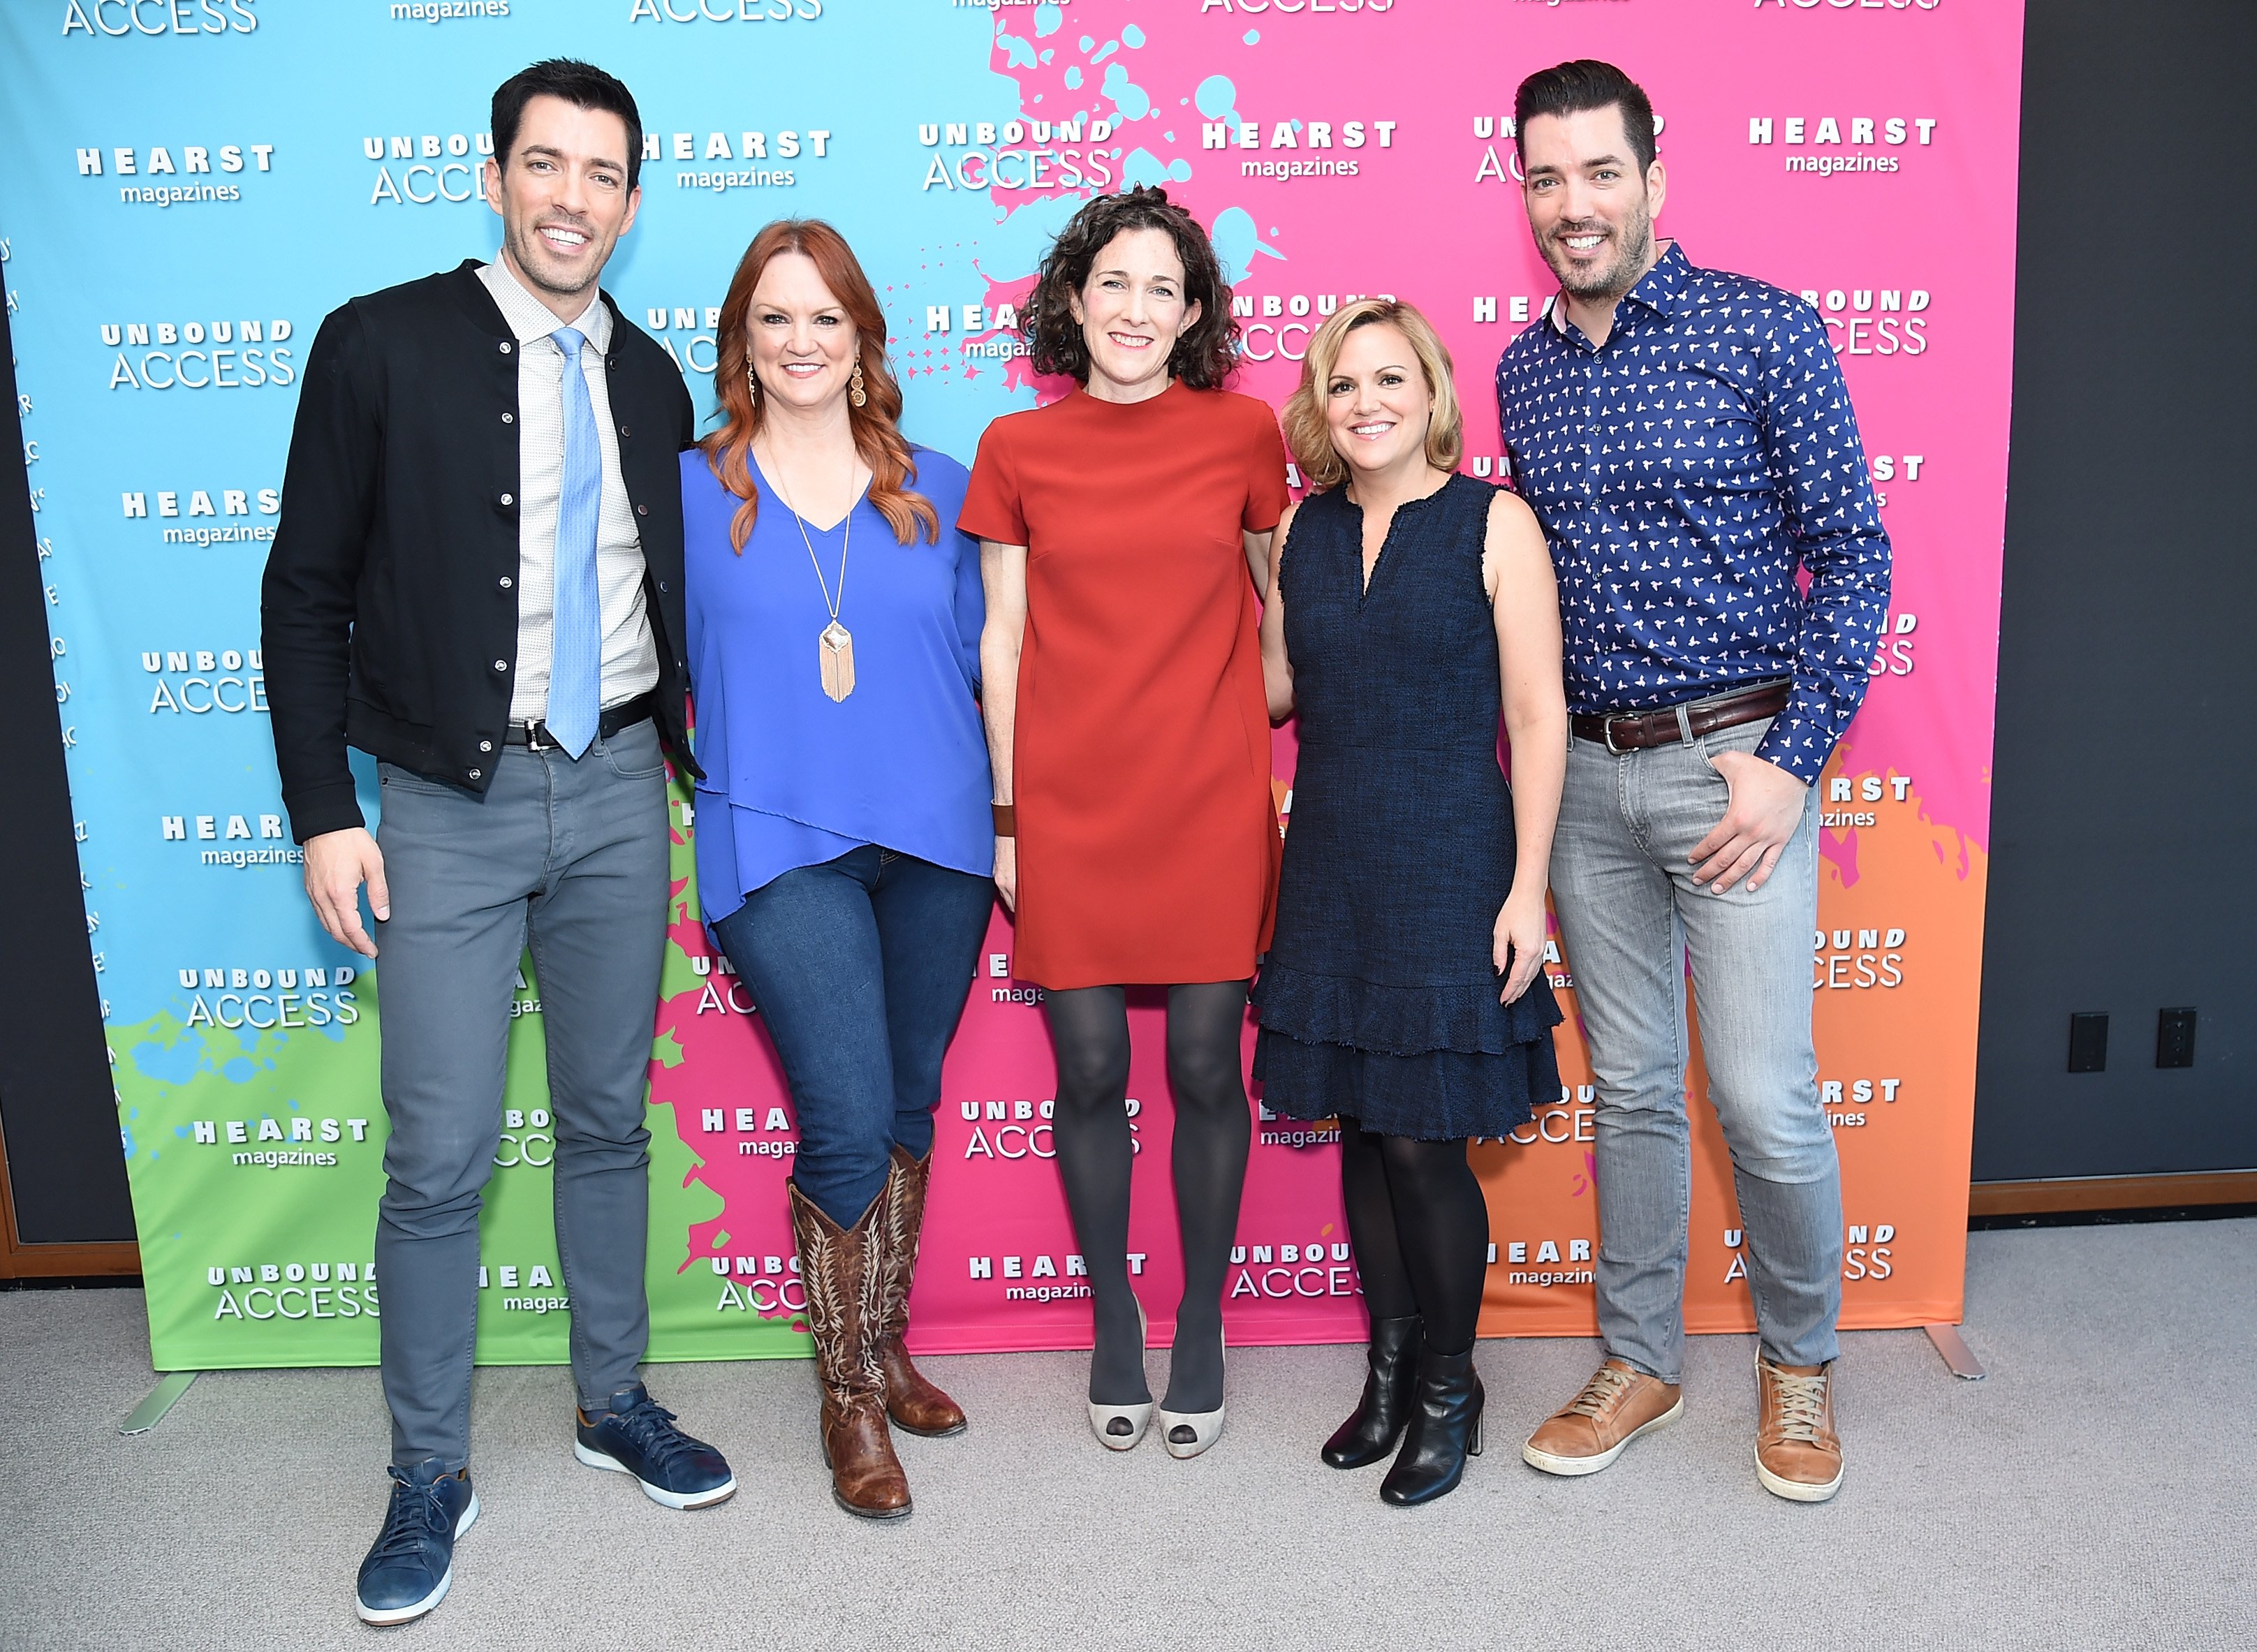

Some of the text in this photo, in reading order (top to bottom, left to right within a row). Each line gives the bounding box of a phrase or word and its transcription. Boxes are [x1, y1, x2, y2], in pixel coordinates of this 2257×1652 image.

[62, 0, 257, 35] ACCESS
[390, 0, 510, 23] magazines
[918, 120, 1113, 145] UNBOUND
[1202, 121, 1395, 149] HEARST
[1749, 117, 1936, 144] HEARST
[363, 133, 495, 158] UNBOU
[640, 130, 830, 160] HEARST
[76, 145, 274, 175] HEARST
[922, 149, 1112, 191] ACCESS
[1241, 156, 1358, 181] magazines
[1785, 151, 1899, 176] magazines
[370, 163, 487, 205] ACCE
[677, 166, 795, 191] magazines
[120, 181, 240, 207] magazines
[1801, 290, 1930, 311] BOUND
[927, 304, 1017, 331] HEA
[101, 319, 292, 345] UNBOUND
[109, 348, 295, 389] ACCESS
[122, 489, 280, 517] HEARS
[163, 524, 276, 546] magazines
[142, 650, 263, 672] UNBOU
[149, 677, 270, 713] ACCE
[1830, 776, 1911, 802] RST
[161, 814, 283, 839] HEAR
[179, 966, 355, 989] UNBOUND
[186, 991, 359, 1028] ACCESS
[1822, 1079, 1900, 1103] RST
[702, 1107, 790, 1132] HEA
[961, 1099, 1140, 1121] UNBOD
[193, 1118, 368, 1143] HEARST
[233, 1148, 337, 1168] magazines
[1229, 1244, 1348, 1264] UNBOU
[1487, 1239, 1590, 1263] EAR
[711, 1255, 800, 1275] UNBO
[969, 1253, 1146, 1278] HEART
[1509, 1267, 1596, 1287] magazin
[716, 1279, 808, 1311] ACC
[1006, 1282, 1096, 1302] magazin
[1230, 1267, 1364, 1298] ACCE
[503, 1297, 571, 1314] magaz
